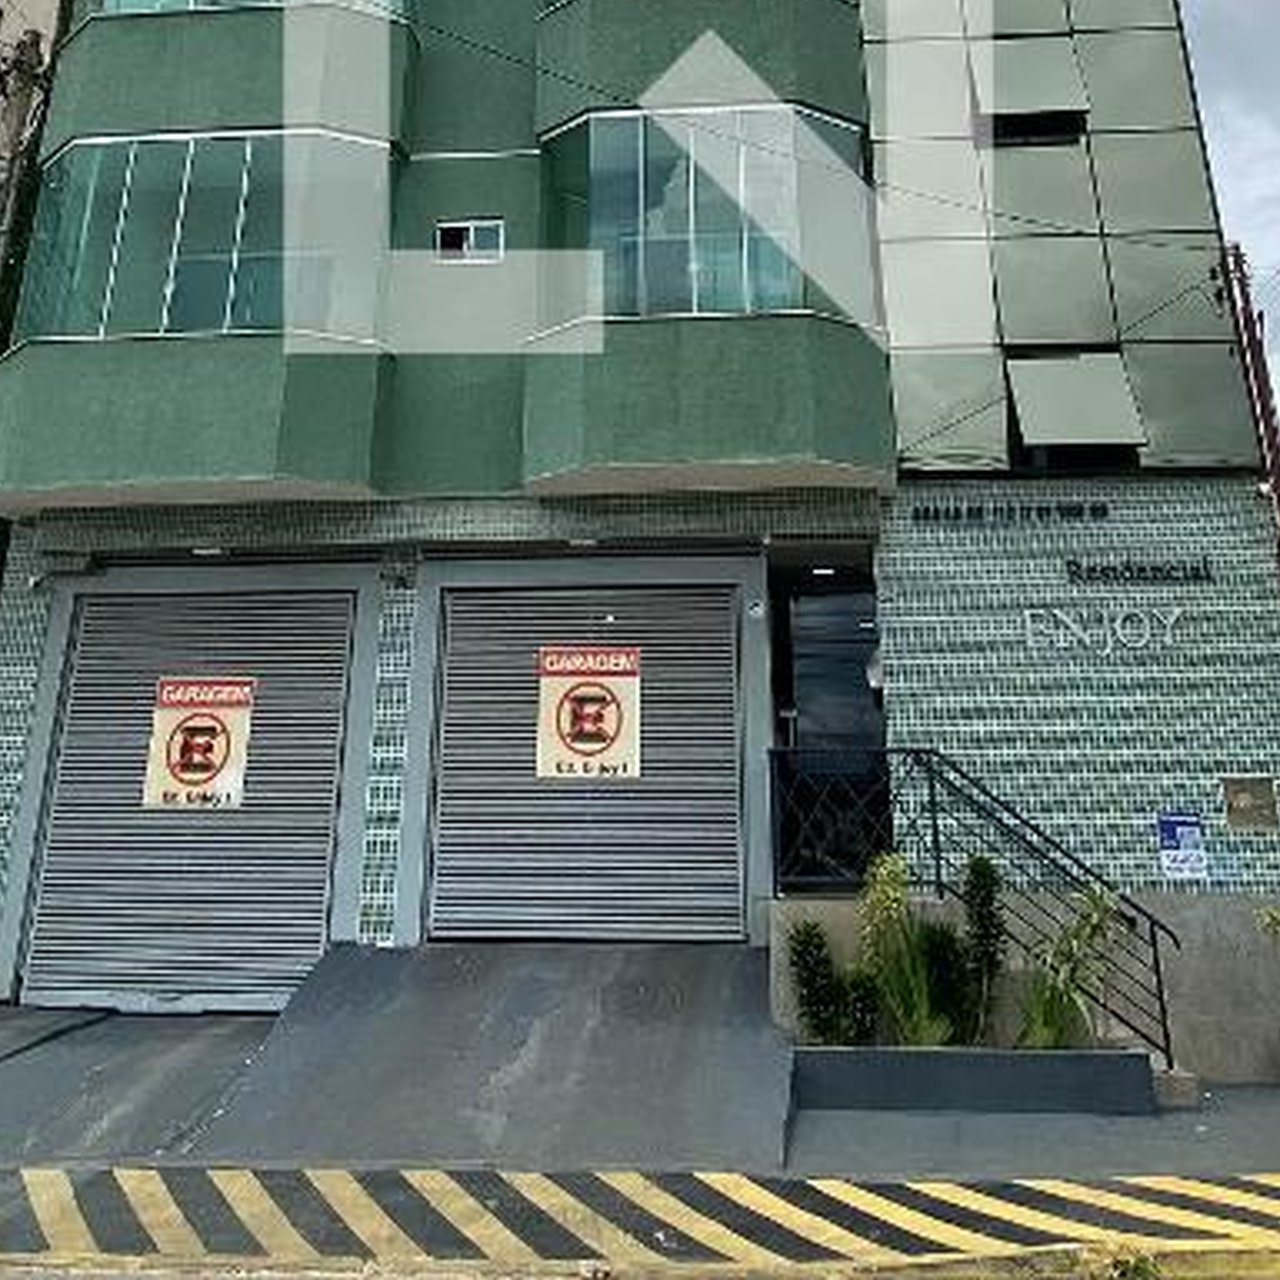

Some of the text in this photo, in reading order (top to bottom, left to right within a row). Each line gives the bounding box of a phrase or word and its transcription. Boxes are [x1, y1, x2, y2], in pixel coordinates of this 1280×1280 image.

[1066, 555, 1217, 588] Residencial
[1023, 608, 1184, 657] ENJOY
[542, 653, 637, 672] GARAGEM
[161, 685, 254, 702] GARAGEM
